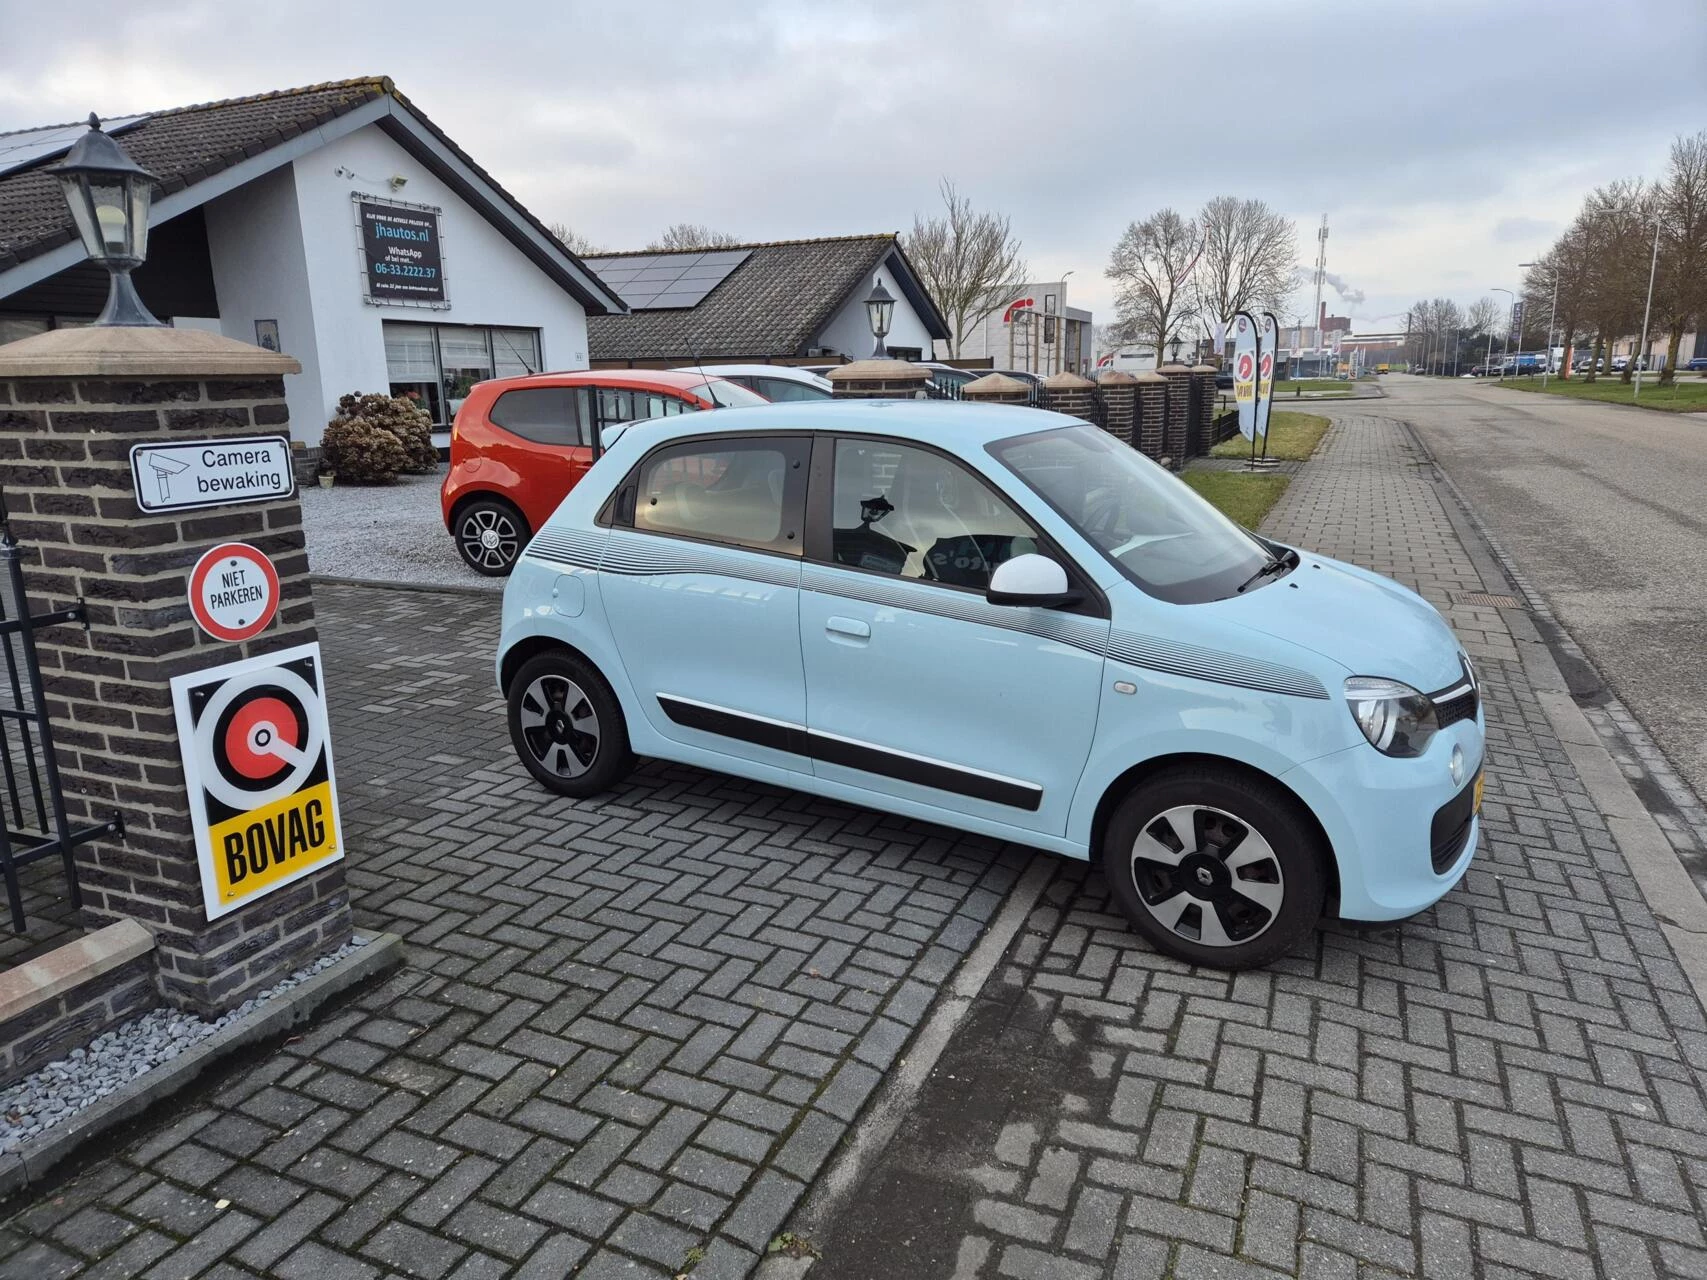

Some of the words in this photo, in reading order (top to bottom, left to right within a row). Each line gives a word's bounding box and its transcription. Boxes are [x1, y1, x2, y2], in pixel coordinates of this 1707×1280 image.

[375, 222, 429, 241] jhautos.nl
[388, 246, 422, 259] WhatsApp
[375, 262, 436, 278] 06-33.2222.37
[201, 449, 271, 468] Camera
[197, 471, 281, 493] bewaking
[221, 569, 246, 589] NIET
[210, 585, 263, 609] PARKEREN
[223, 798, 325, 885] BOVAG
